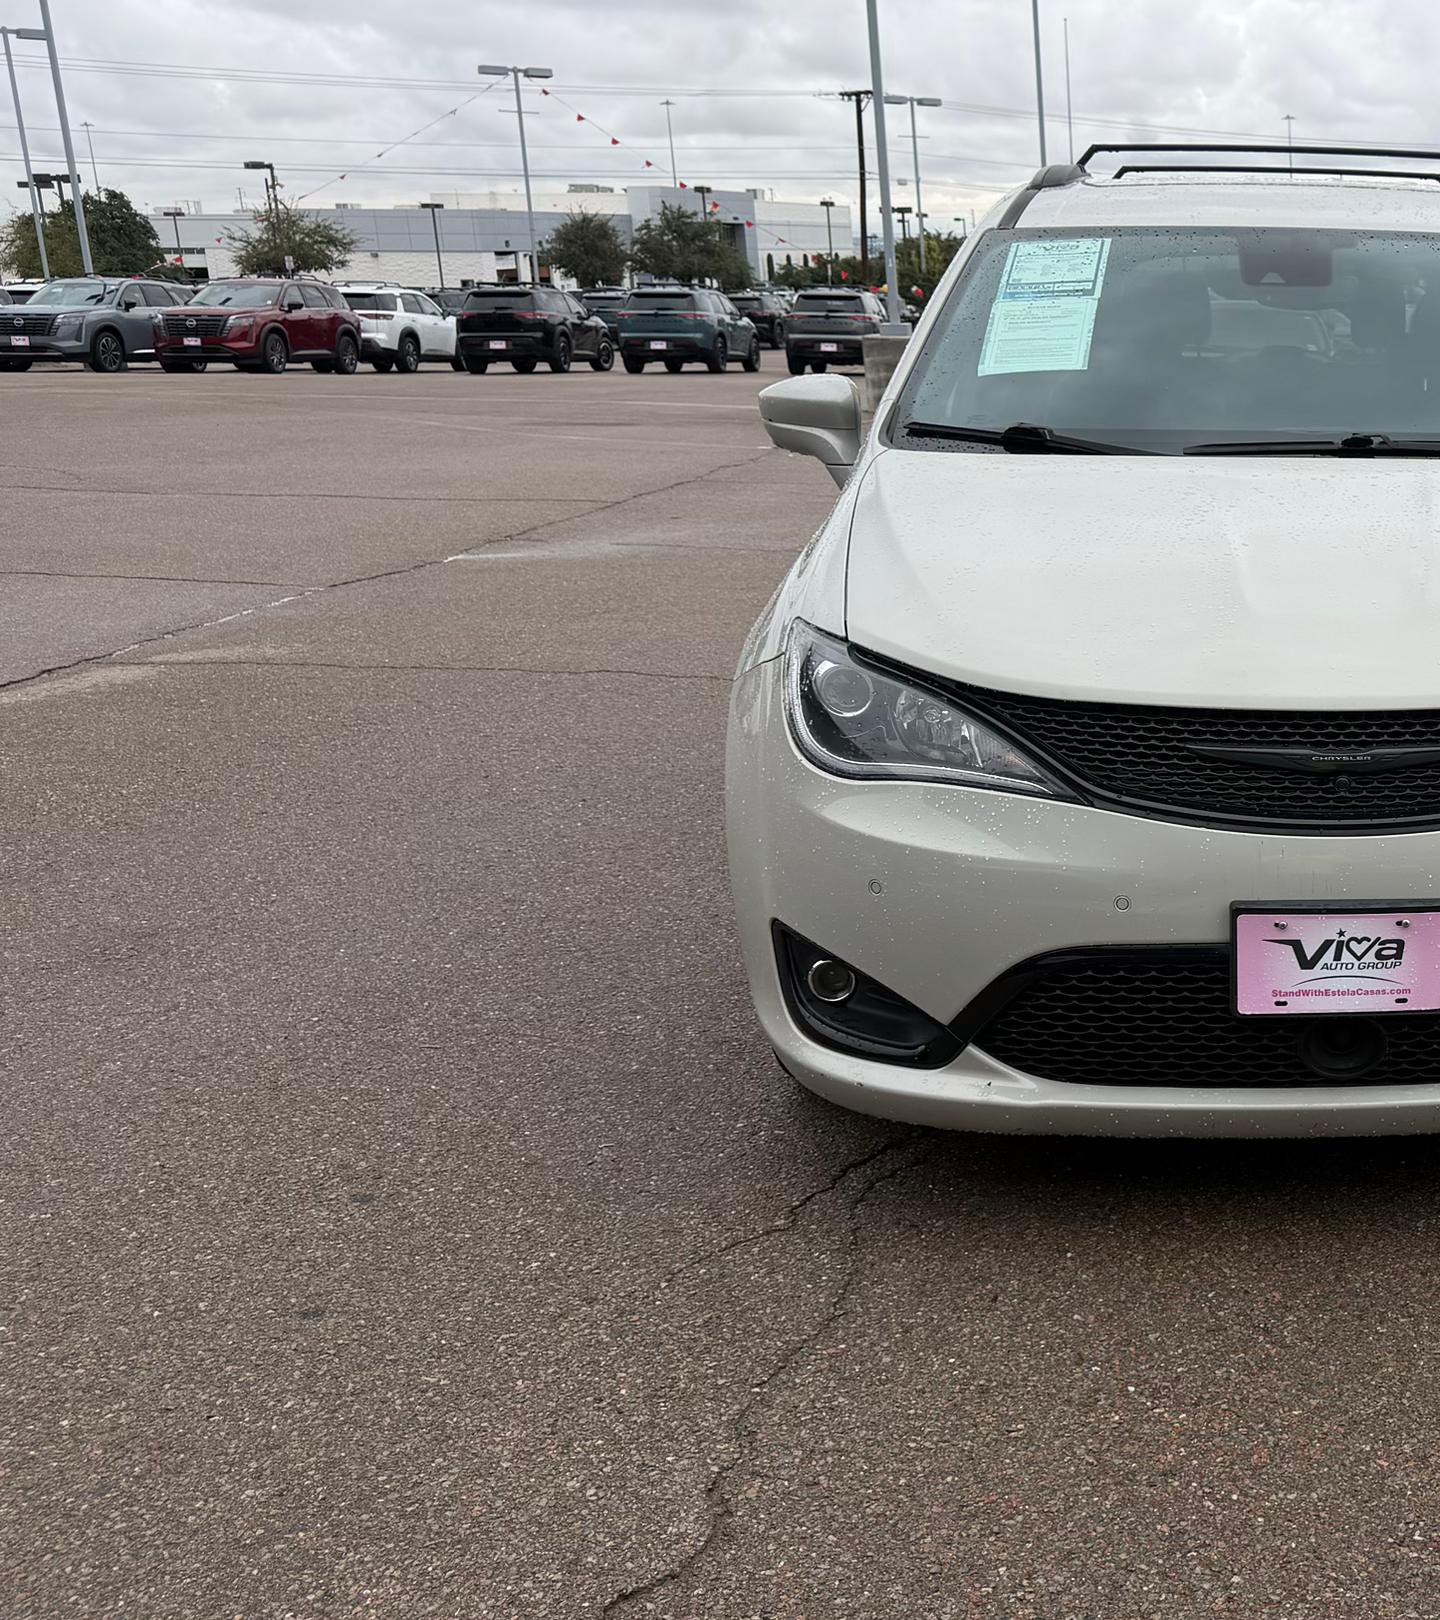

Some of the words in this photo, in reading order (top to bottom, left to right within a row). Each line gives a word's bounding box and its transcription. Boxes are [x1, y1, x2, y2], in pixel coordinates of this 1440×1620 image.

[1320, 961, 1355, 971] AUTO
[1357, 961, 1403, 971] GROUP
[1271, 987, 1412, 998] StandWithEstelaCasas.com
